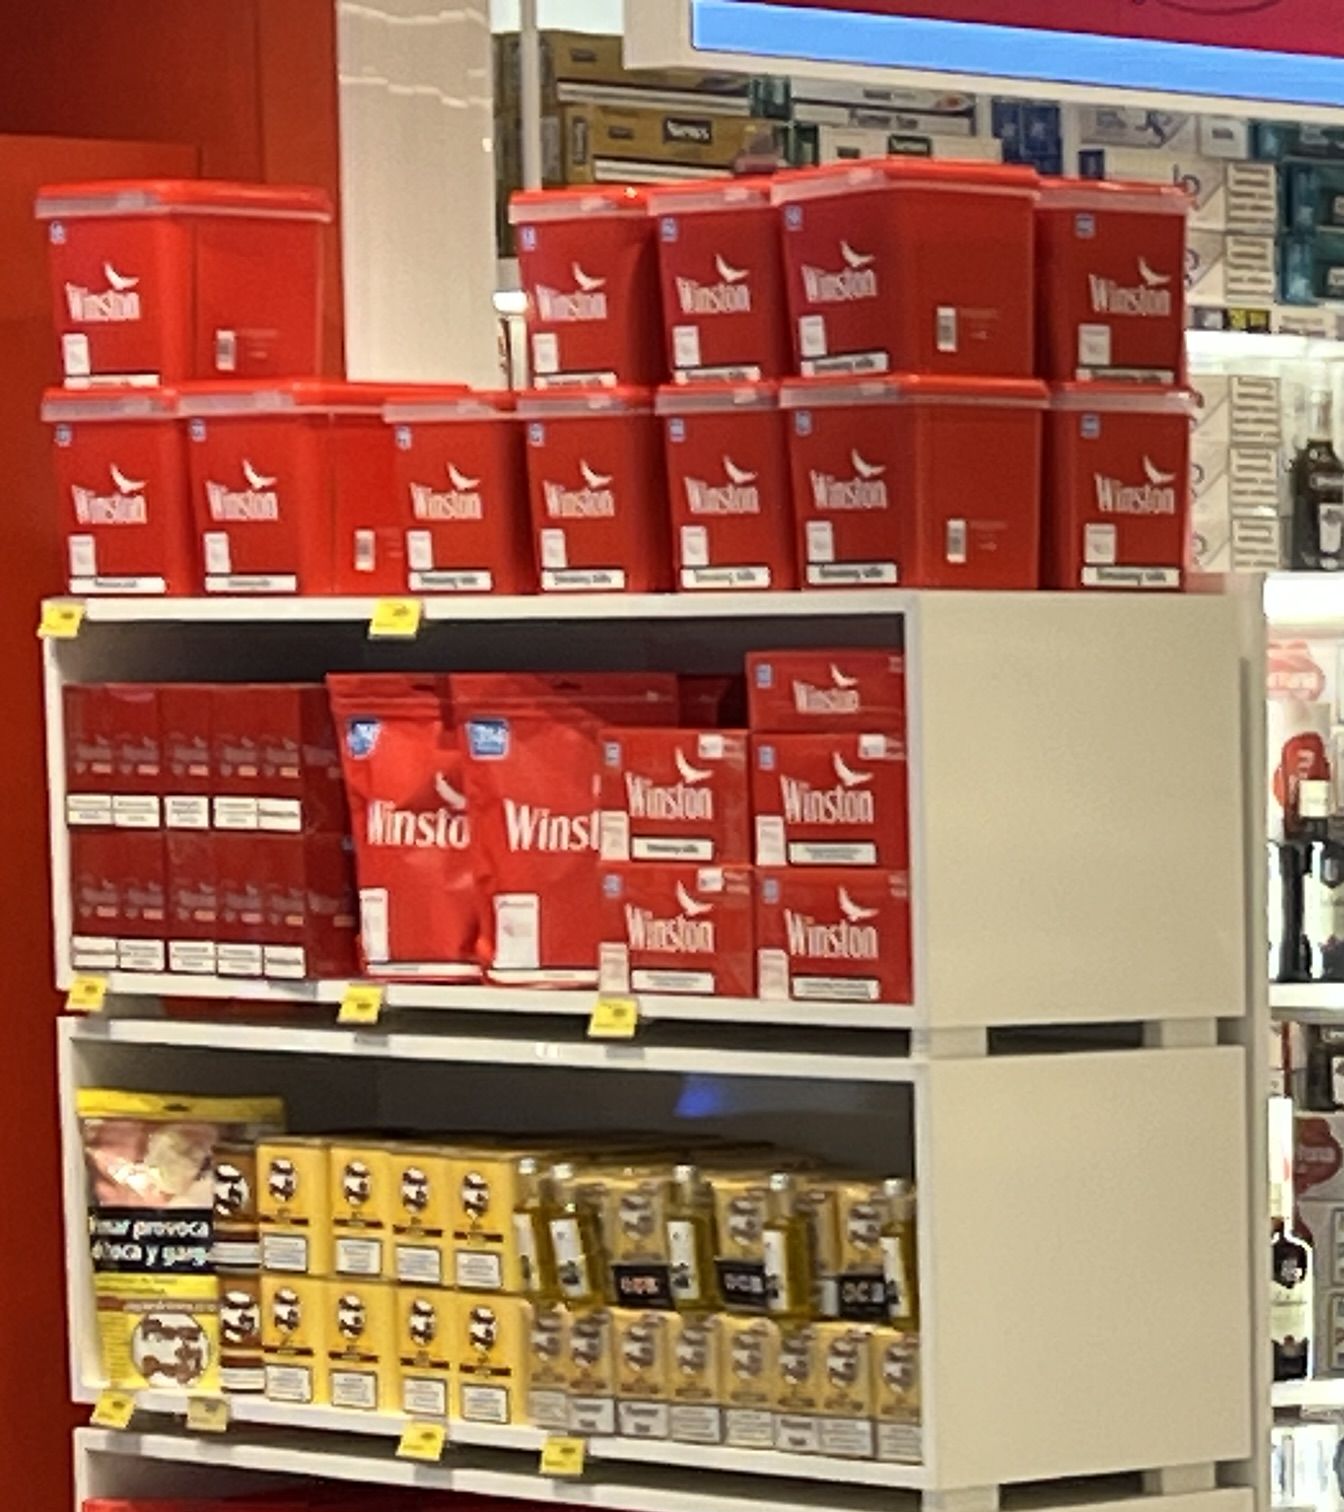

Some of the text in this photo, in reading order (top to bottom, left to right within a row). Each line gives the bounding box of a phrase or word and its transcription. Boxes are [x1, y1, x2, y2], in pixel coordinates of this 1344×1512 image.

[66, 282, 141, 321] Winston
[536, 282, 607, 321] Winston
[676, 277, 751, 314] Winston
[802, 265, 877, 302] Winston
[1089, 275, 1171, 316] Winston
[71, 486, 146, 524] Winston
[206, 480, 279, 522] Winston
[411, 483, 483, 521] Winston
[544, 479, 615, 518] Winston
[685, 476, 759, 515] Winston
[810, 469, 888, 510] Winston
[1095, 473, 1175, 515] Winston
[627, 775, 712, 820] Winston
[782, 777, 873, 823] Winston
[626, 906, 713, 953] Winston
[785, 910, 878, 958] Winston
